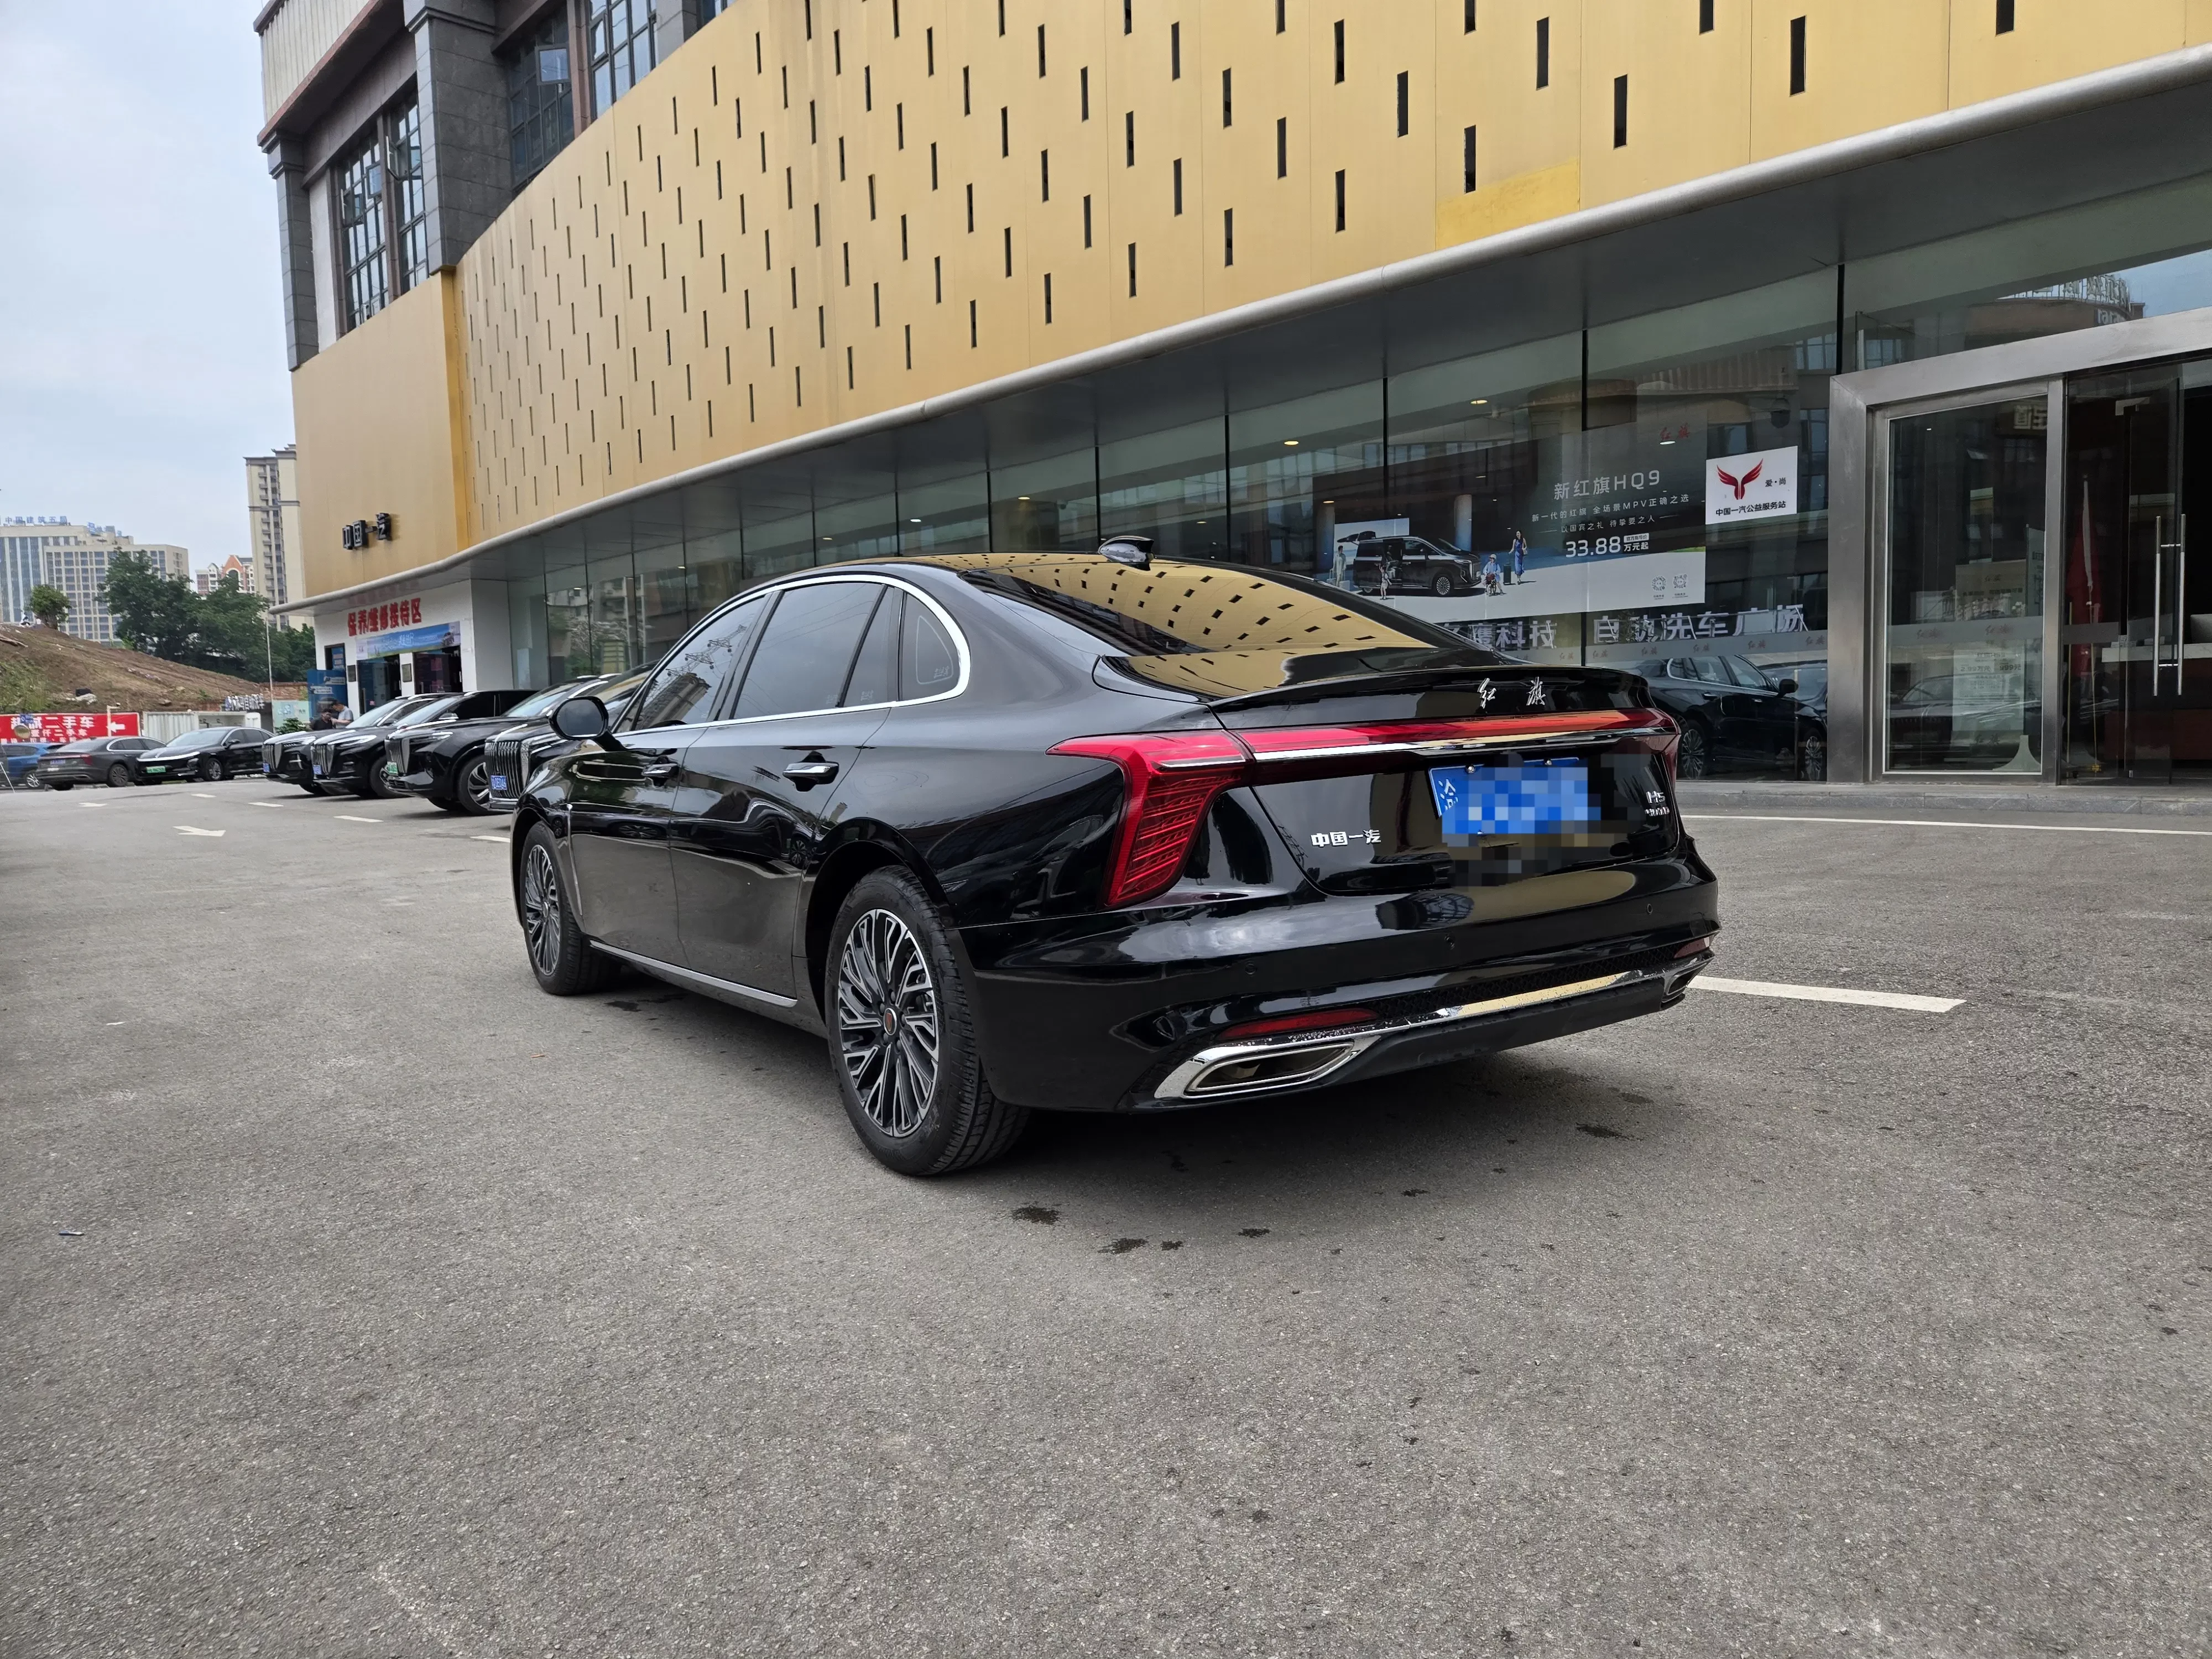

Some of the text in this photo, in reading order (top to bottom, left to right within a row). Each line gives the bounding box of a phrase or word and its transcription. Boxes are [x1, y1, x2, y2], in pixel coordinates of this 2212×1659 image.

[1553, 470, 1660, 500] 新红旗HQ9
[1531, 494, 1689, 522] 新一代的红旗 全场景MPV正确之选
[1716, 500, 1786, 516] 中国一汽公益服务站
[1561, 521, 1604, 533] 以国宾之礼
[1566, 536, 1649, 557] 33.88 万元起
[1477, 676, 1546, 709] 红旗
[1646, 791, 1665, 803] H5
[1311, 829, 1381, 847] 中国一汽
